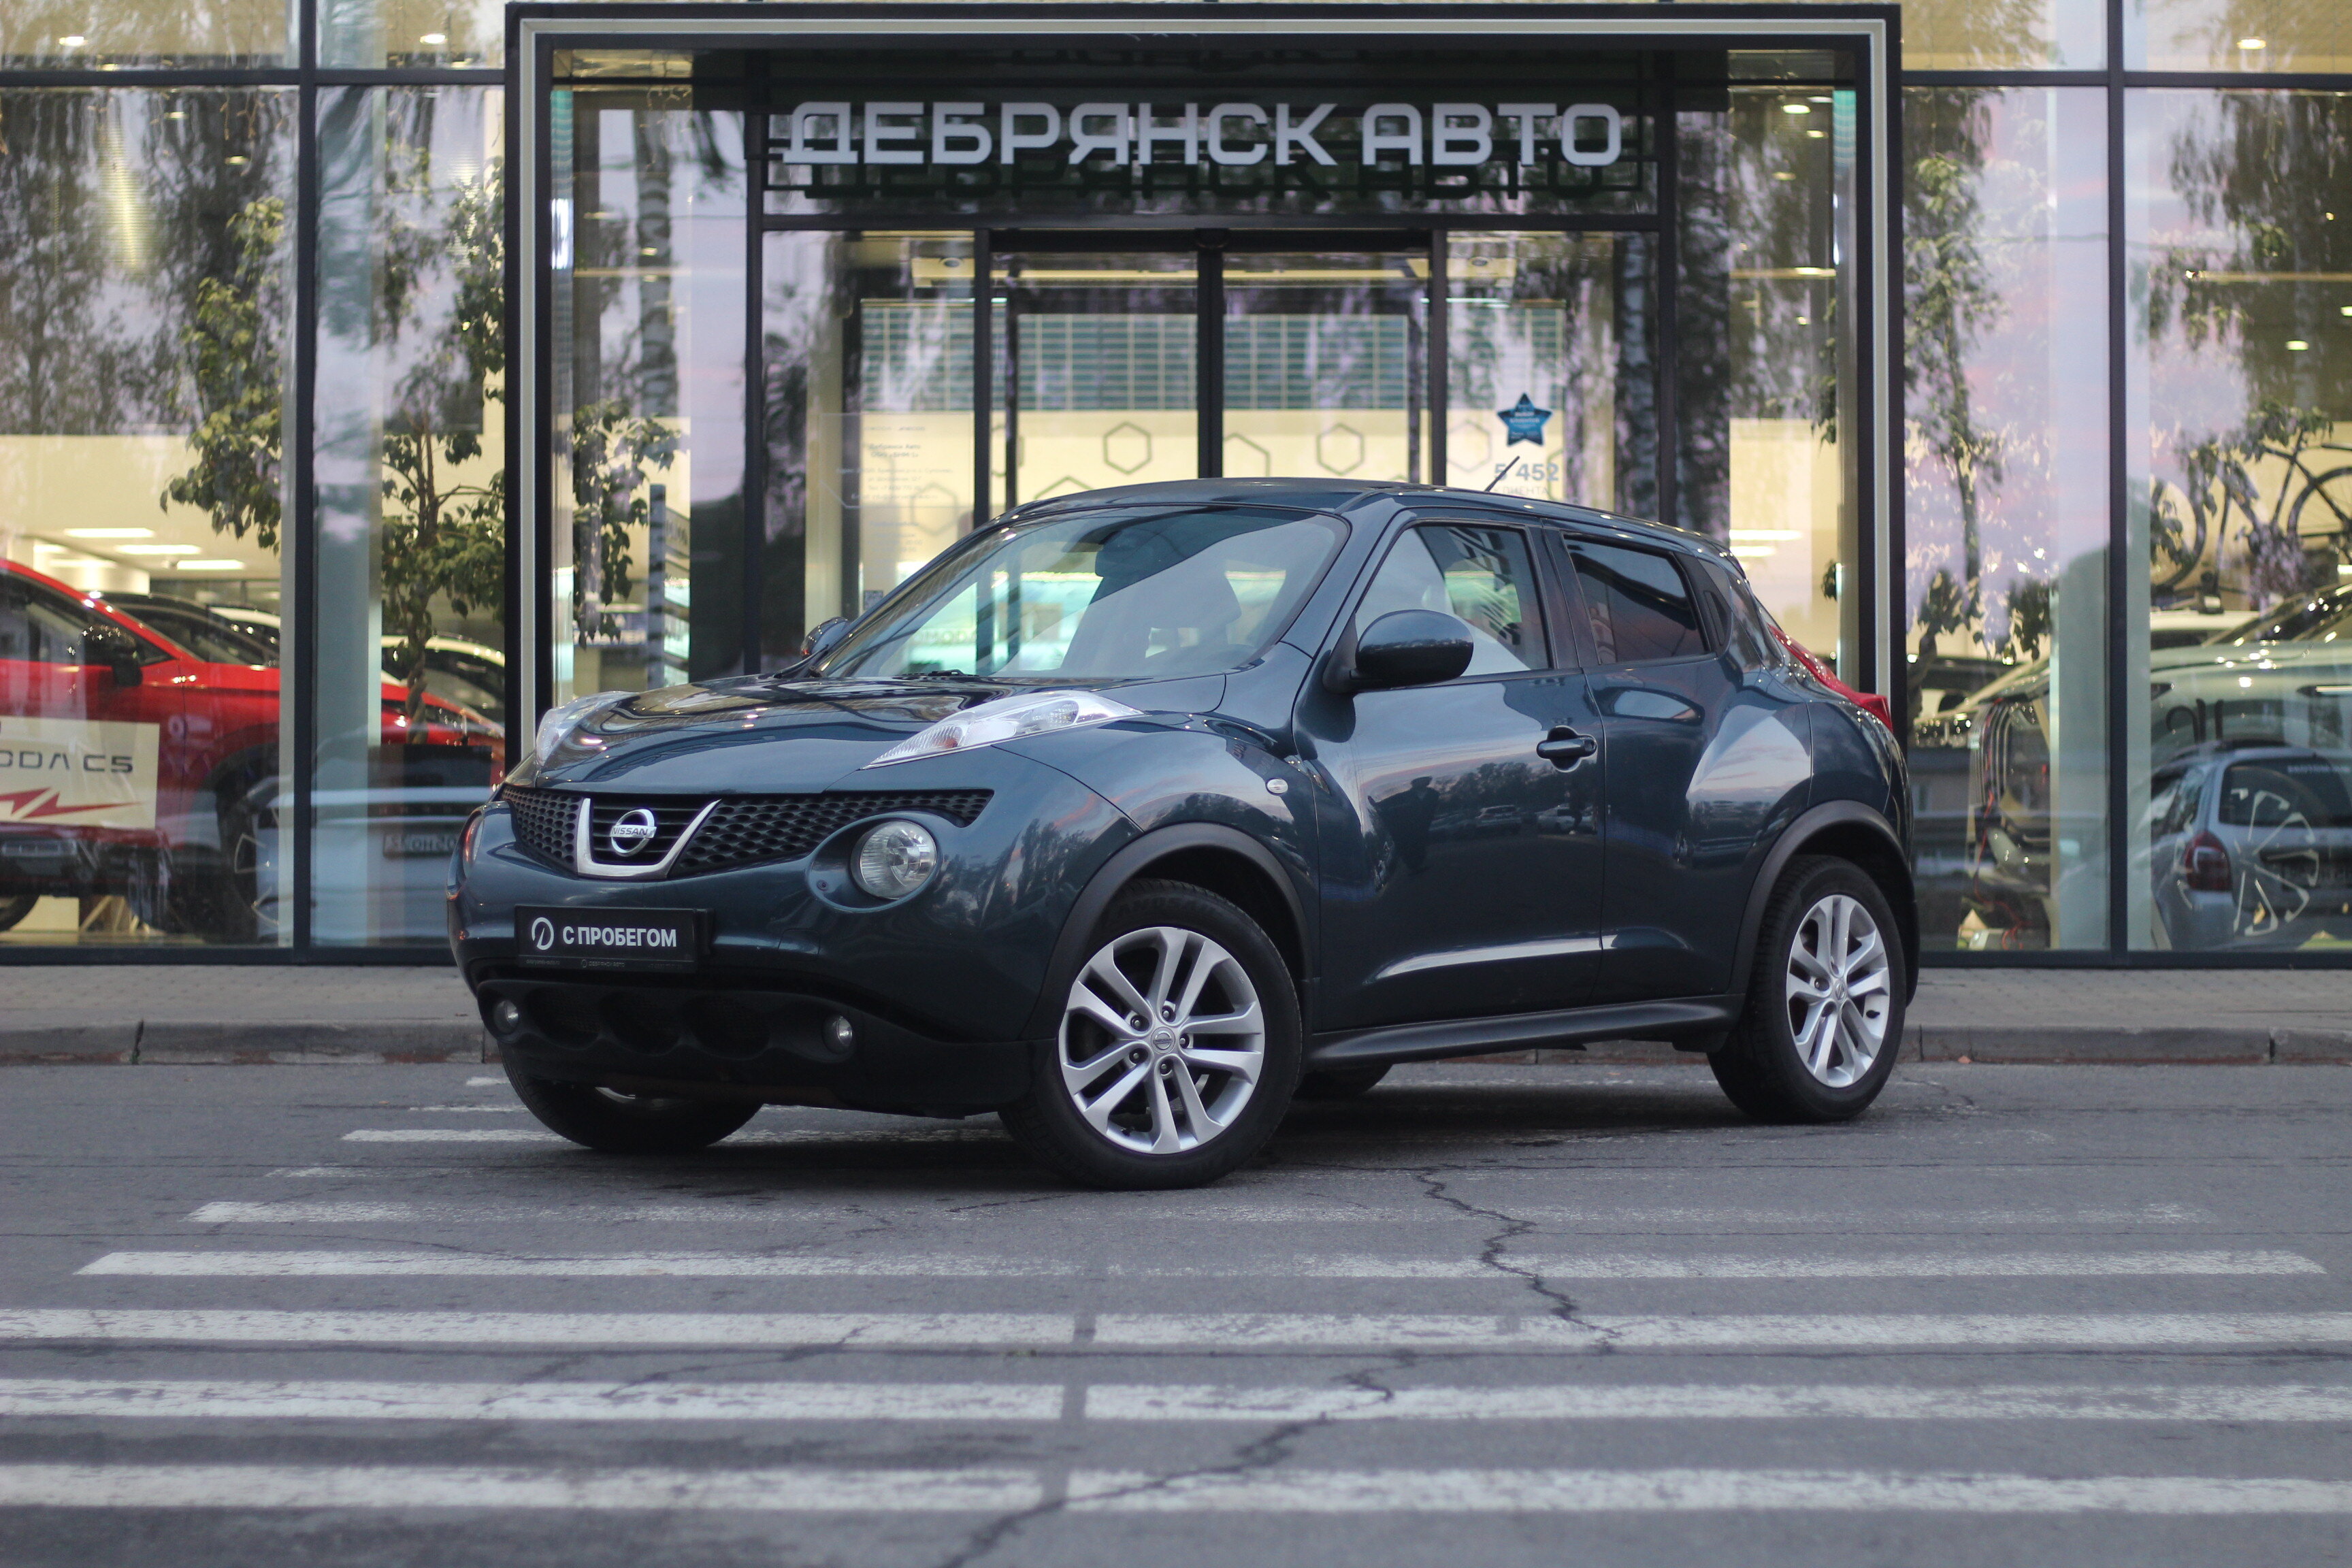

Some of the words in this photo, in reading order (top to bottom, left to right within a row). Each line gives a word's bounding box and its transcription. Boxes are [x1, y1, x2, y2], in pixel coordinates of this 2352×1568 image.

[783, 101, 1339, 165] ДЕБРЯНСК
[1362, 103, 1623, 166] АВТО
[1494, 463, 1507, 480] 5
[1516, 463, 1559, 480] 452
[83, 754, 133, 773] C5
[612, 827, 649, 836] NISSAN
[563, 926, 575, 945] С
[578, 926, 677, 947] ПРОБЕГОМ
